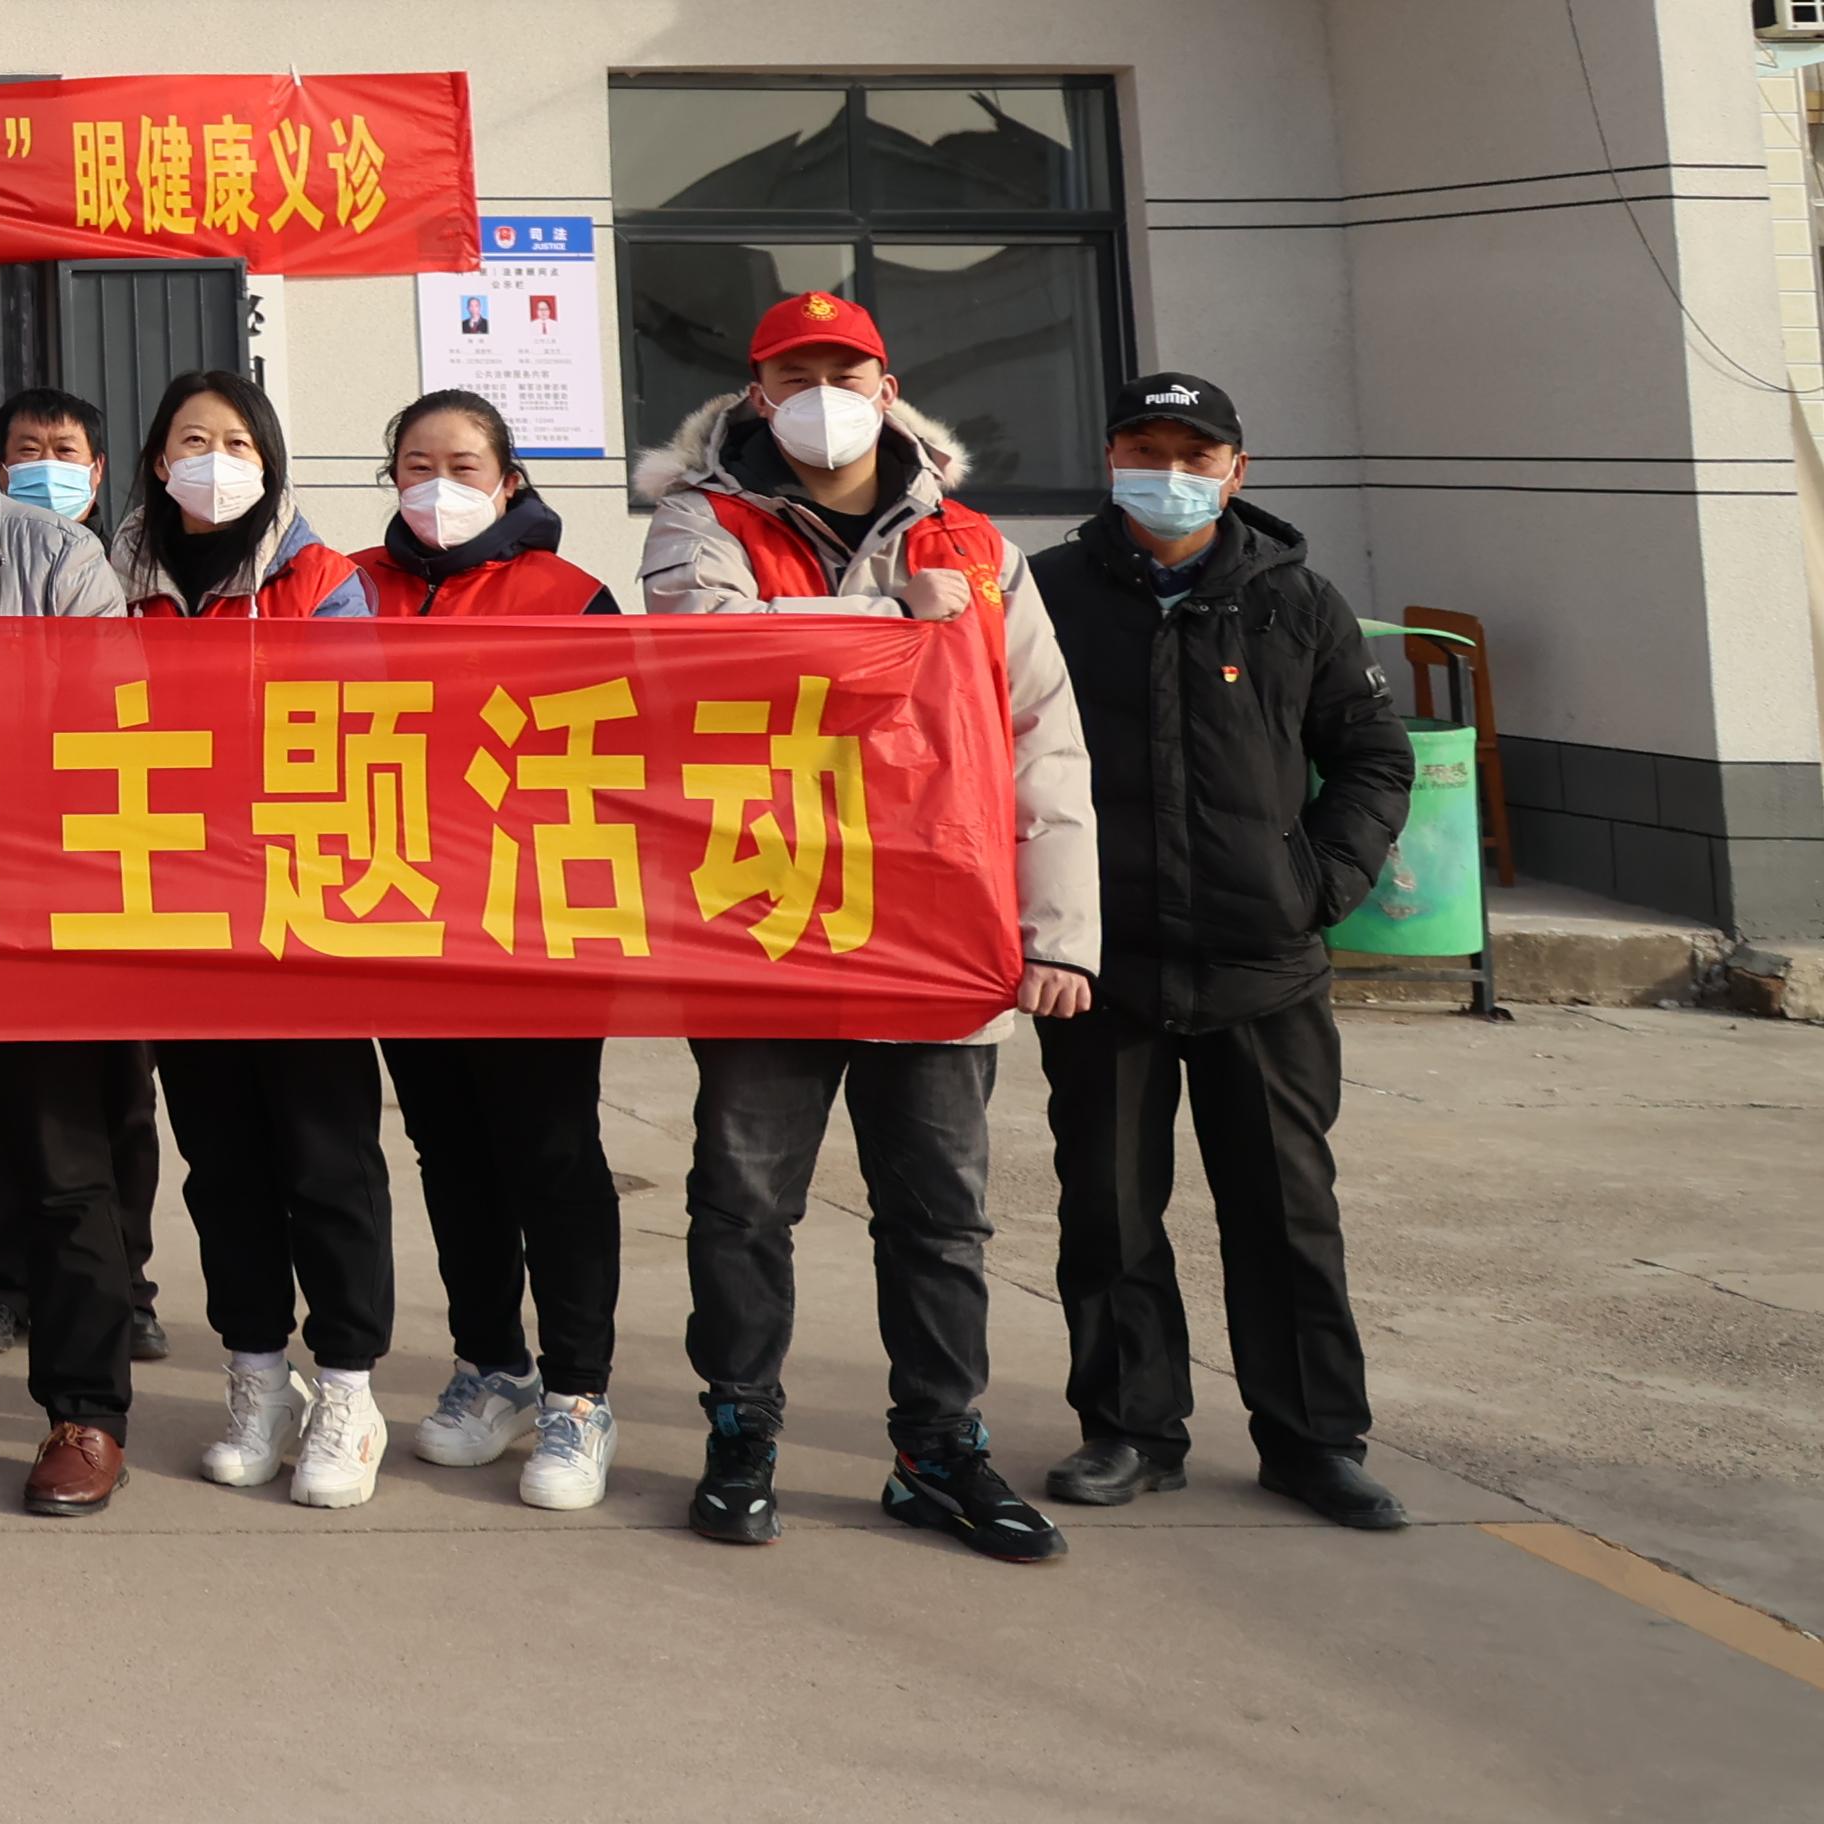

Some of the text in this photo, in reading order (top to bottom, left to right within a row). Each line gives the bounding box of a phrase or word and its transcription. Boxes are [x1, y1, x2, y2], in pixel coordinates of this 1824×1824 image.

[529, 227, 568, 242] 司法
[532, 242, 567, 251] JUSTICE
[1145, 393, 1190, 406] PUMA
